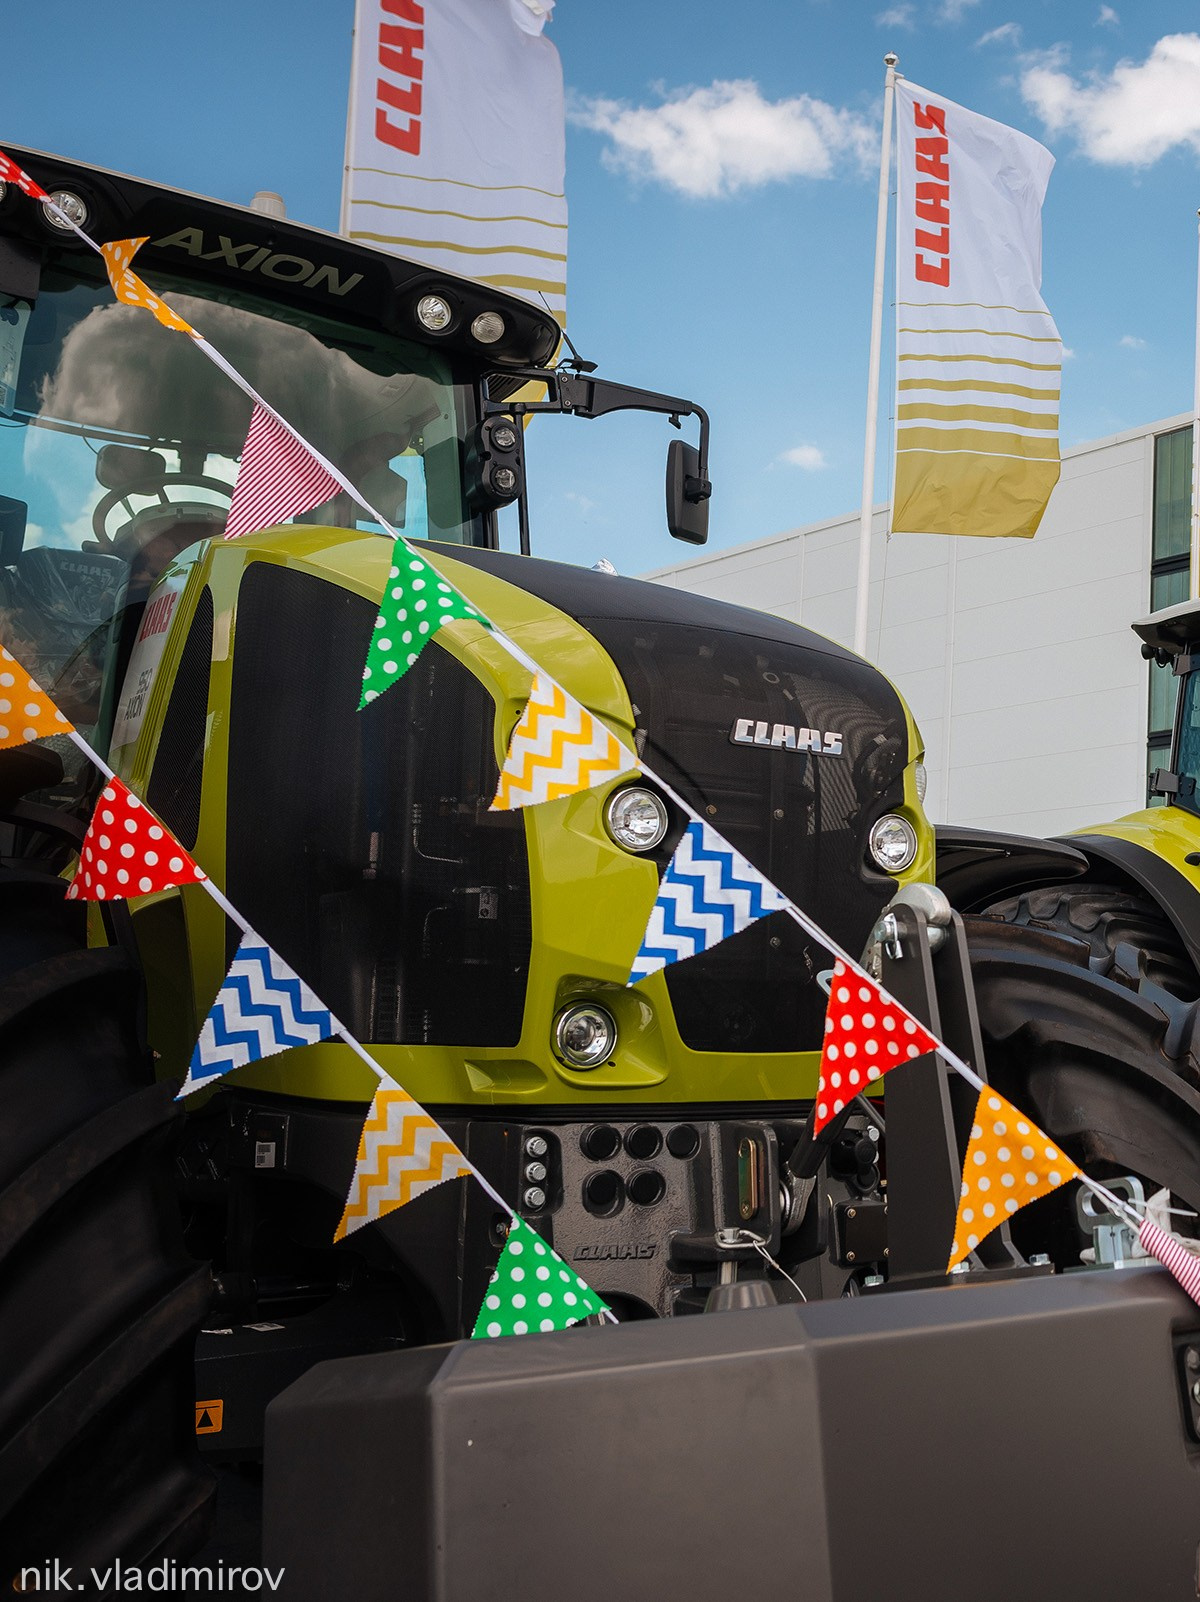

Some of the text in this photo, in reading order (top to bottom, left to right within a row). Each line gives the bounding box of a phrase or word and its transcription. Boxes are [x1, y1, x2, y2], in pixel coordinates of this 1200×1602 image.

[914, 100, 950, 288] CLAAS
[151, 226, 365, 296] AXION
[734, 718, 843, 756] CLAAS
[573, 1245, 657, 1261] CLAAS
